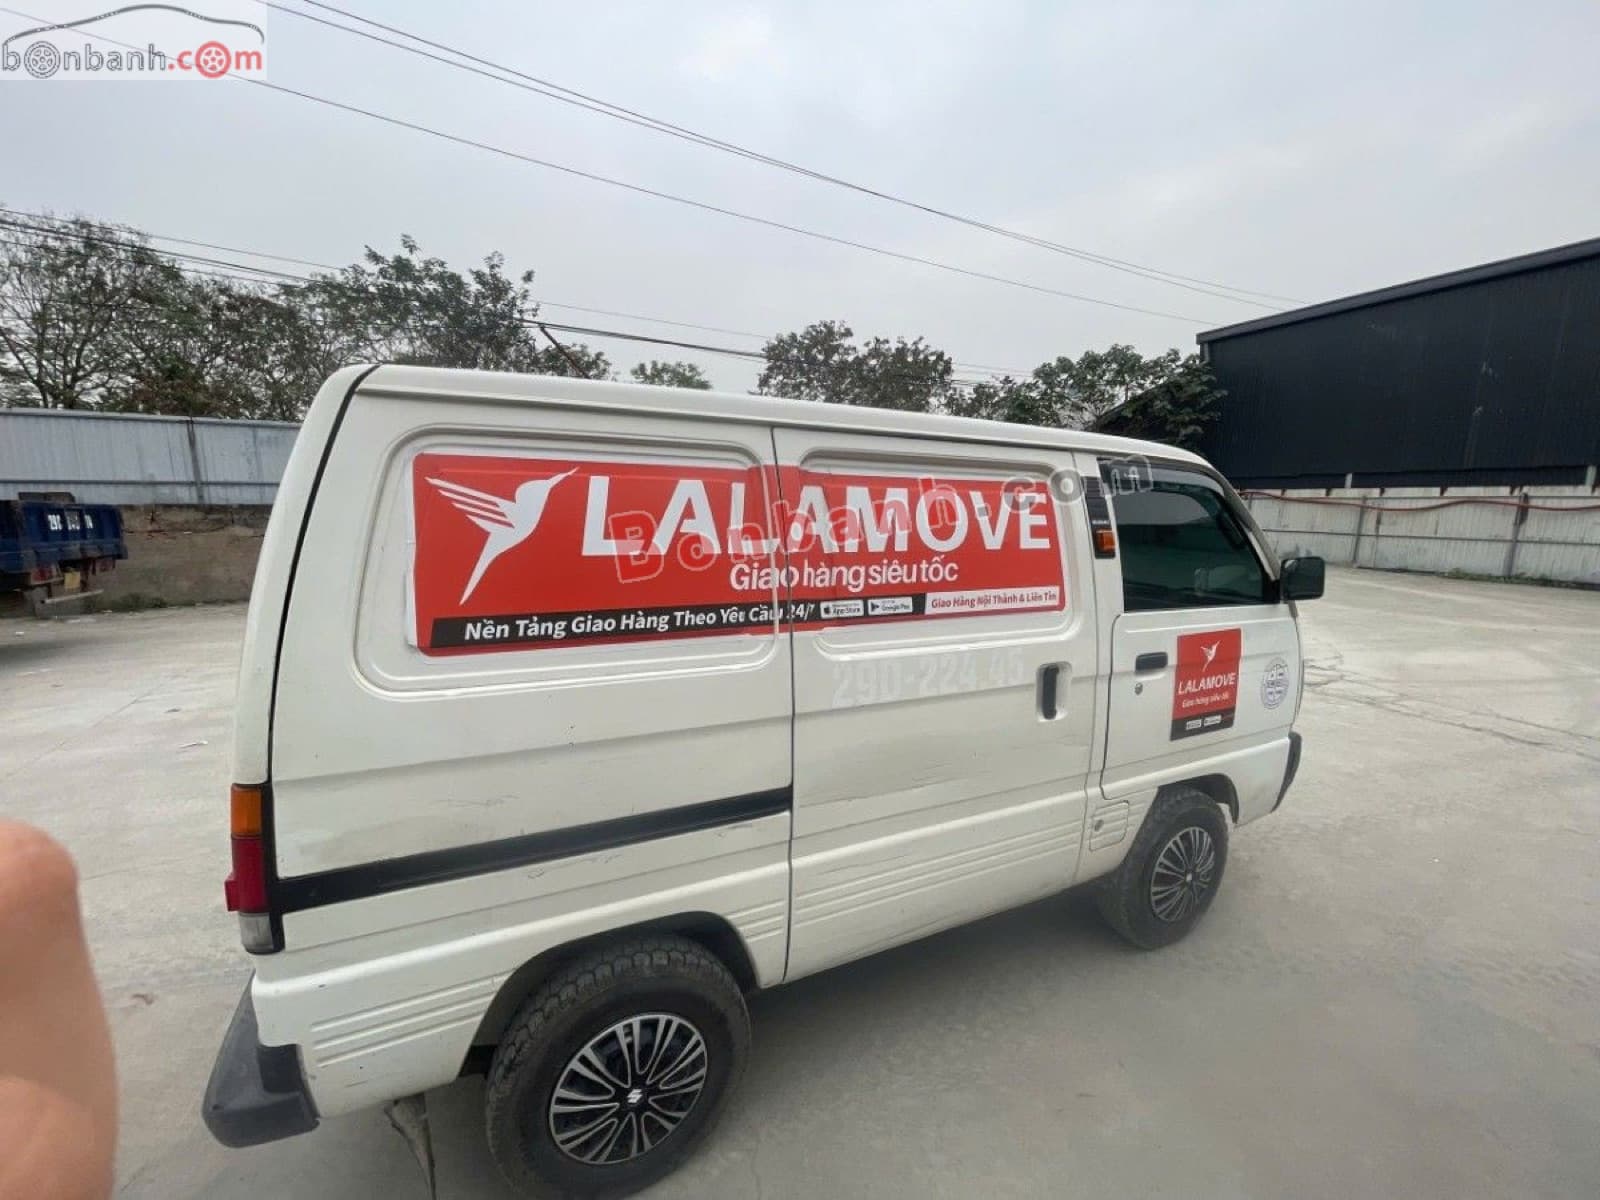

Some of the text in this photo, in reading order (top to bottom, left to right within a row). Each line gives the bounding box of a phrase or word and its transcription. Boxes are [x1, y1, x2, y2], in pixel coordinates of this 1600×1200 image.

[582, 476, 1051, 556] LALAMOVE
[730, 555, 959, 592] Giao hàng siêu tốc
[931, 598, 951, 608] Giao
[464, 619, 510, 641] Nền
[515, 616, 567, 640] Tảng
[571, 615, 616, 633] Giao
[620, 611, 670, 632] Hàng
[673, 610, 716, 626] Theo
[1178, 672, 1237, 695] LALAMOVE
